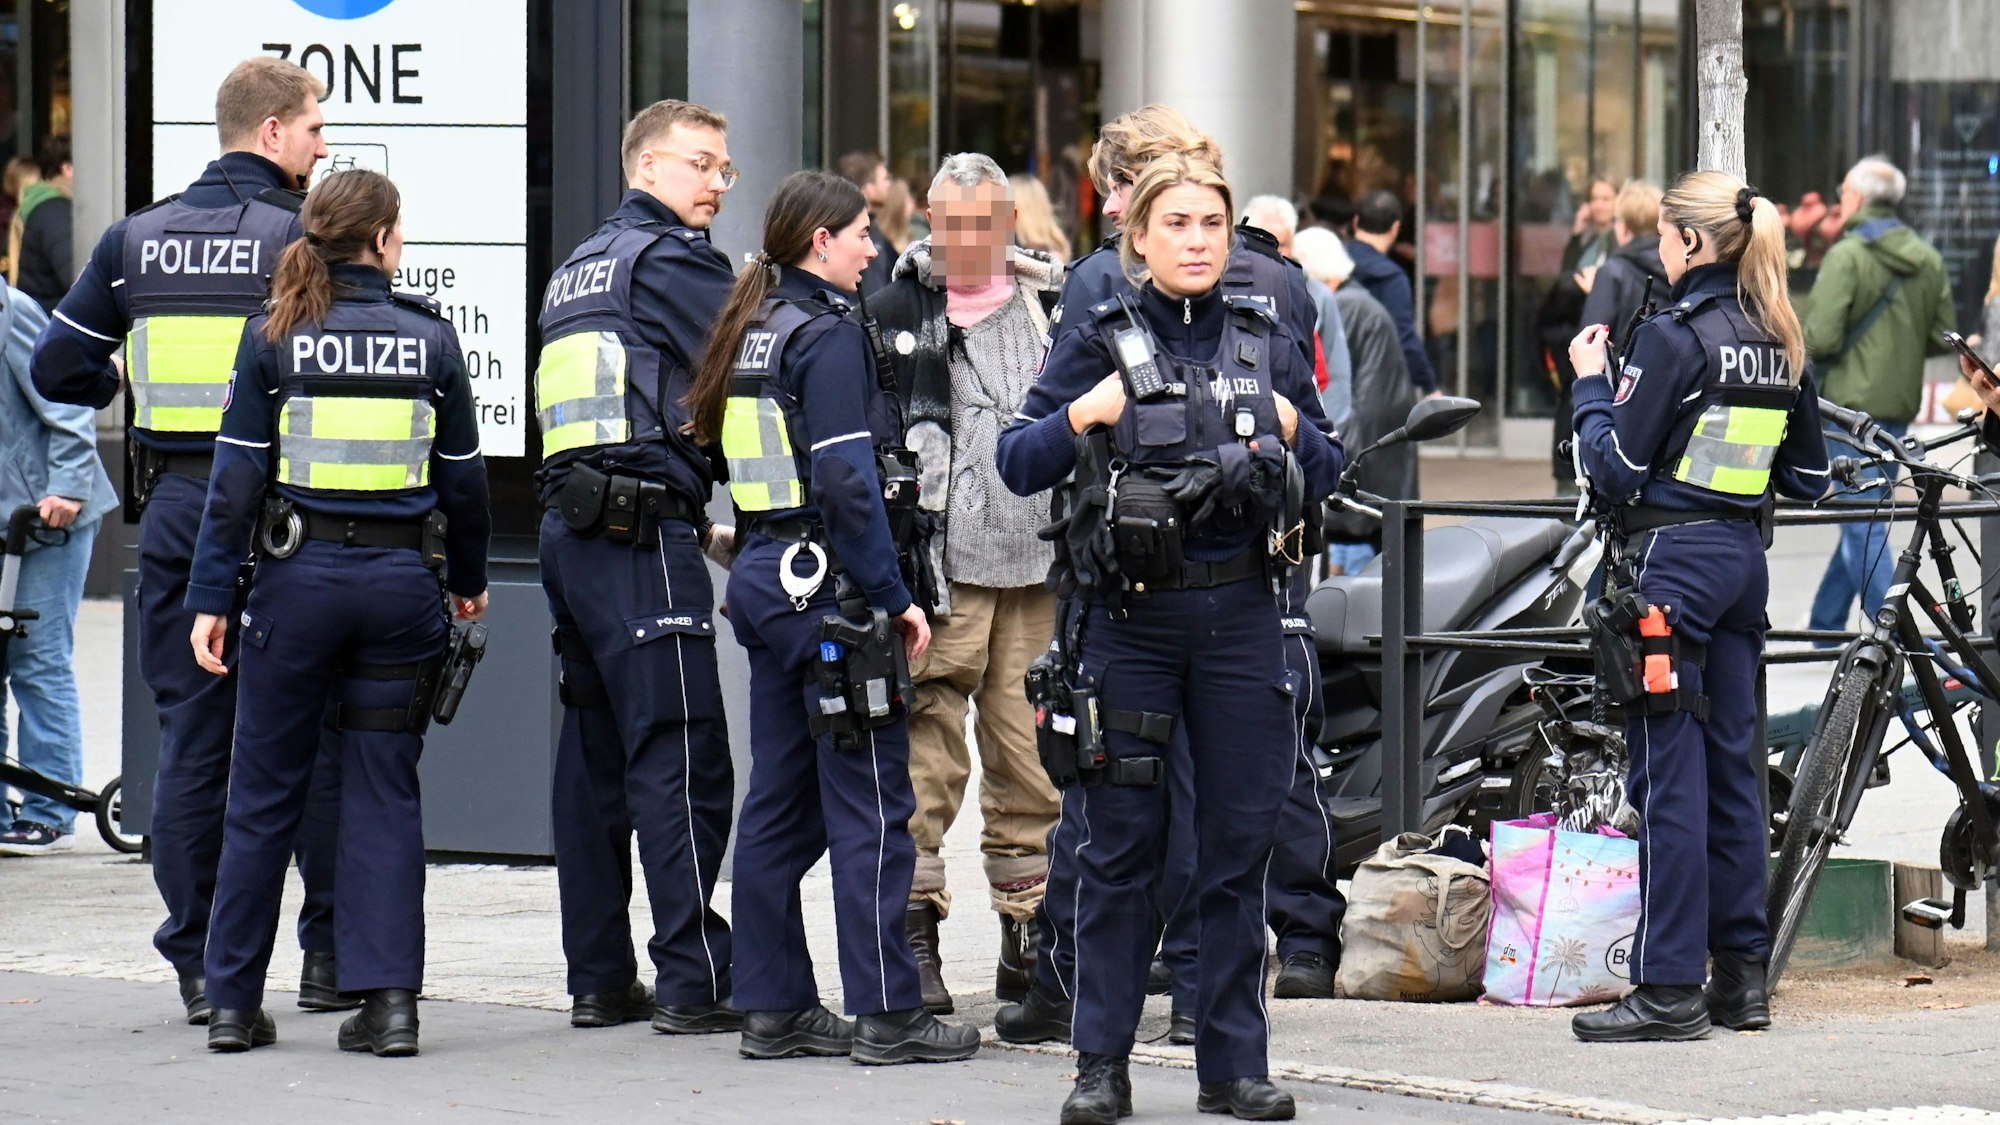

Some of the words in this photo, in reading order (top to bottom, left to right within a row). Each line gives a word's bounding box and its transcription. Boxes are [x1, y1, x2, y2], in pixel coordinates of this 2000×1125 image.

[140, 239, 261, 275] POLIZEI
[545, 257, 618, 314] POLIZEI
[292, 334, 427, 376] POLIZEI
[733, 332, 778, 370] IZEI
[1719, 345, 1796, 387] POLIZ
[656, 616, 693, 627] POLIZEI
